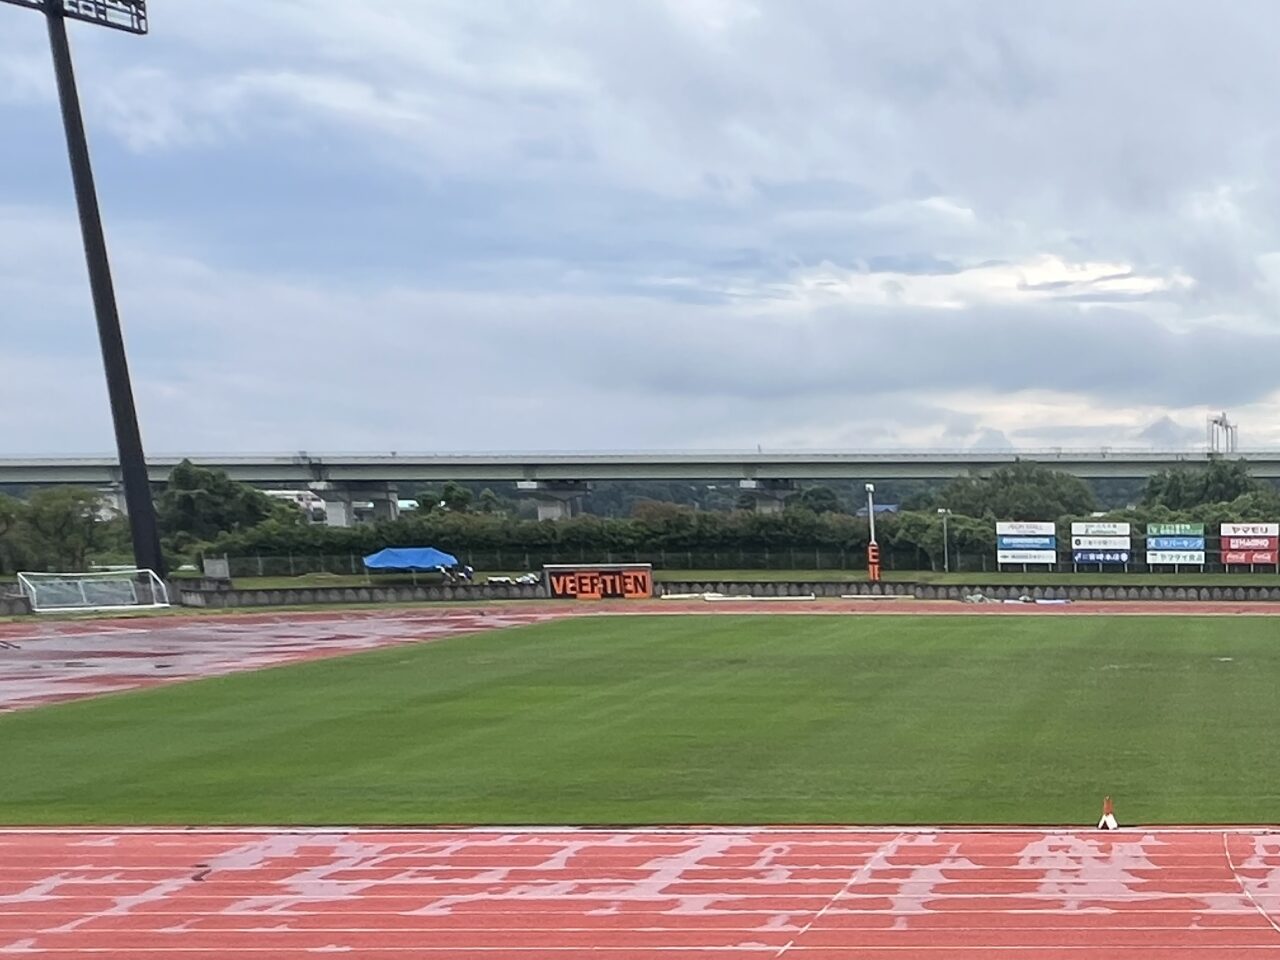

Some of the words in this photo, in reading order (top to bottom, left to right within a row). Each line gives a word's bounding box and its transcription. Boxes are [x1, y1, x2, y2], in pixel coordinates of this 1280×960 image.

[1231, 526, 1268, 534] ヤマモリ
[551, 574, 647, 594] VEERTIEN
